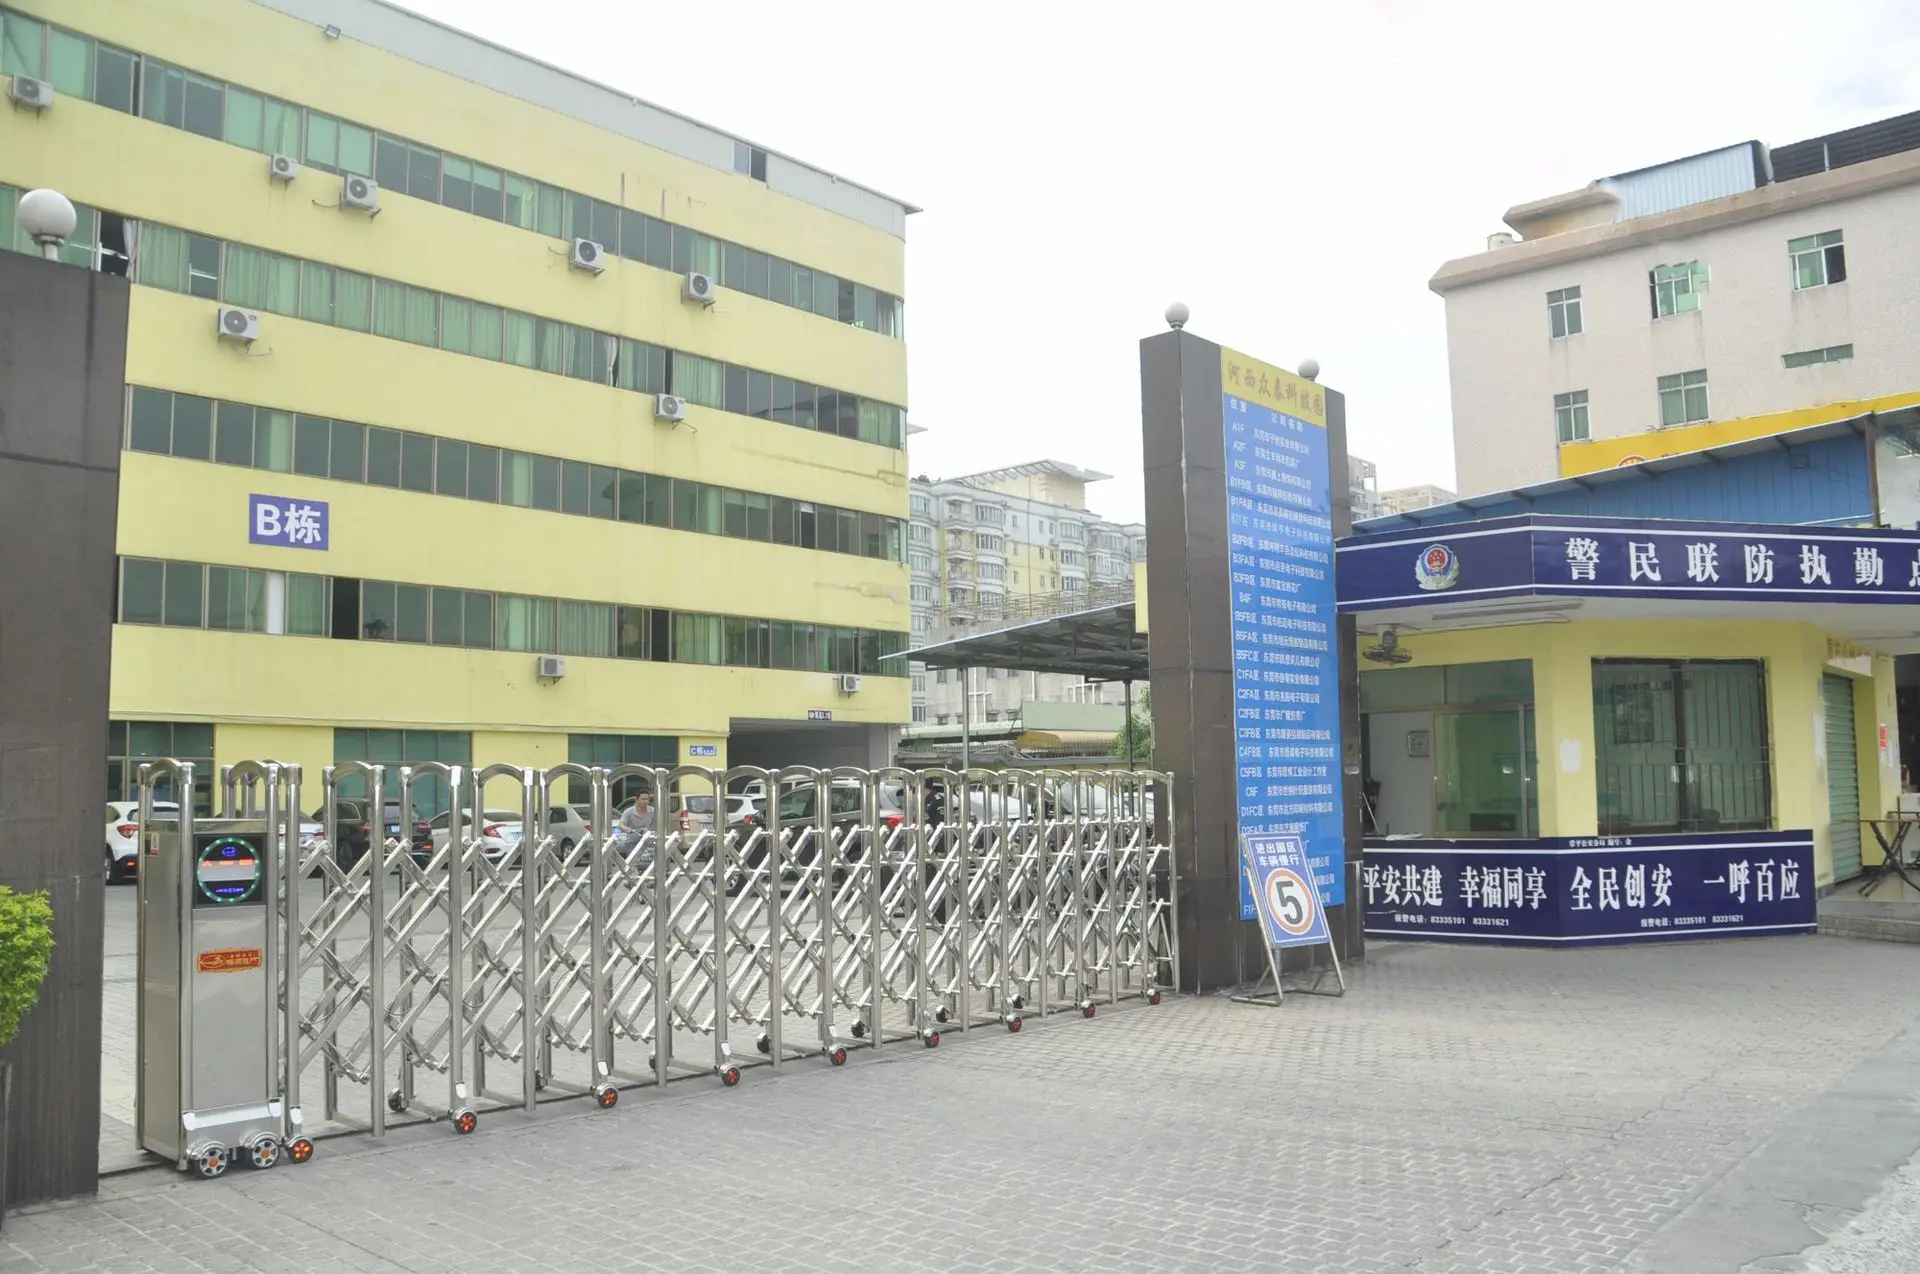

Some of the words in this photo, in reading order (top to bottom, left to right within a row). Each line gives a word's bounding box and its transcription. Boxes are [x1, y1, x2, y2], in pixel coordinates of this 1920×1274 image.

[256, 503, 322, 544] B栋
[1259, 854, 1299, 867] 车辆慢行
[1275, 880, 1303, 925] 5
[1363, 864, 1444, 906] 平安共建
[1459, 865, 1547, 909] 幸福同享
[1570, 864, 1673, 911] 全民创安
[1703, 858, 1801, 904] 一呼百应
[1473, 917, 1509, 926] 83331621
[1712, 914, 1744, 924] 83331621
